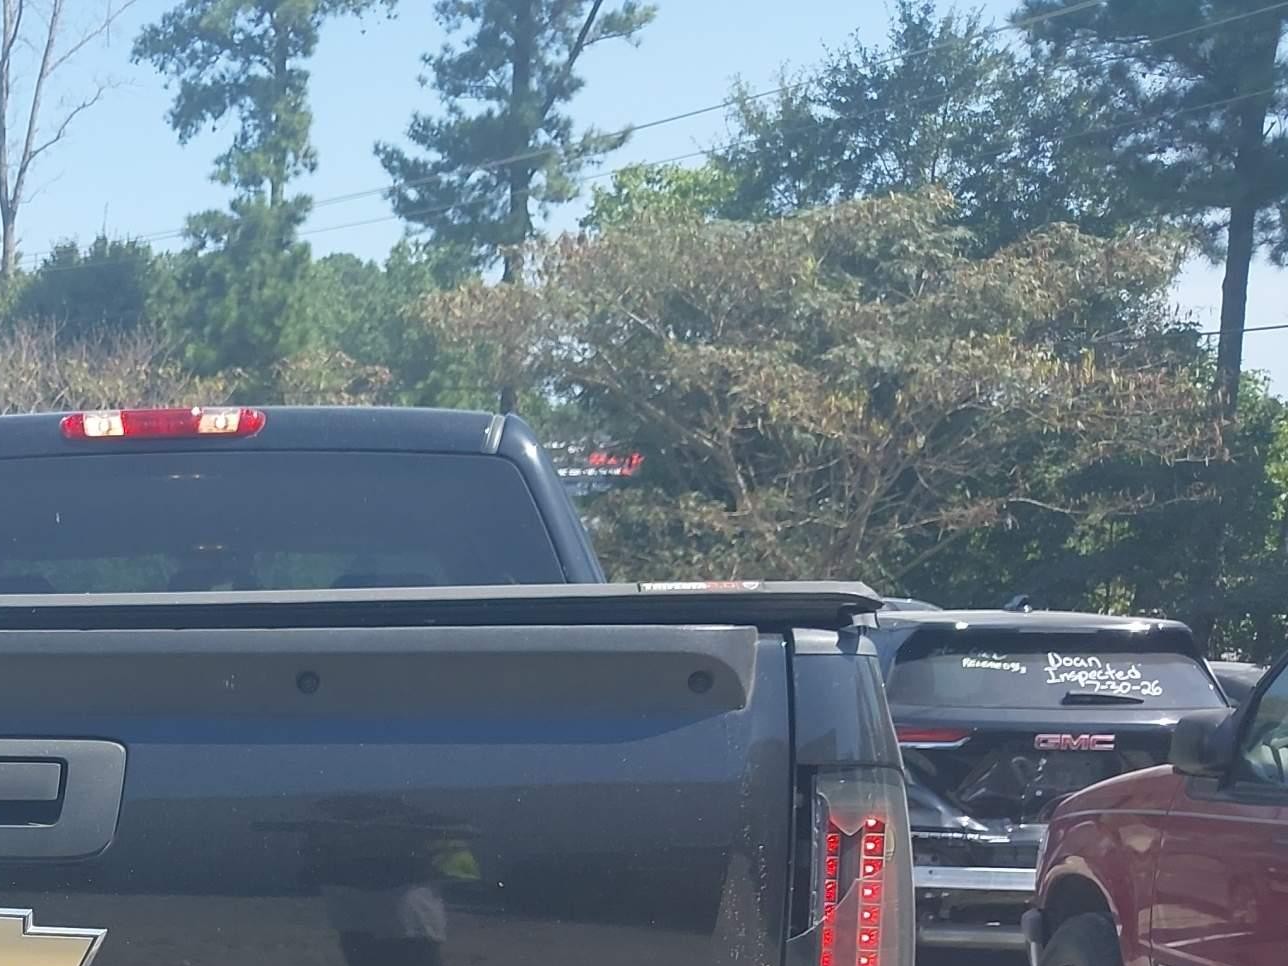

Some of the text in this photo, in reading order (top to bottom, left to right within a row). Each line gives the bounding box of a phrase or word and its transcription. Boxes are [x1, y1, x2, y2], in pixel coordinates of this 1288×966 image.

[1044, 664, 1142, 687] Inspected
[1086, 680, 1163, 695] 7-30-26
[1034, 733, 1116, 750] GMC
